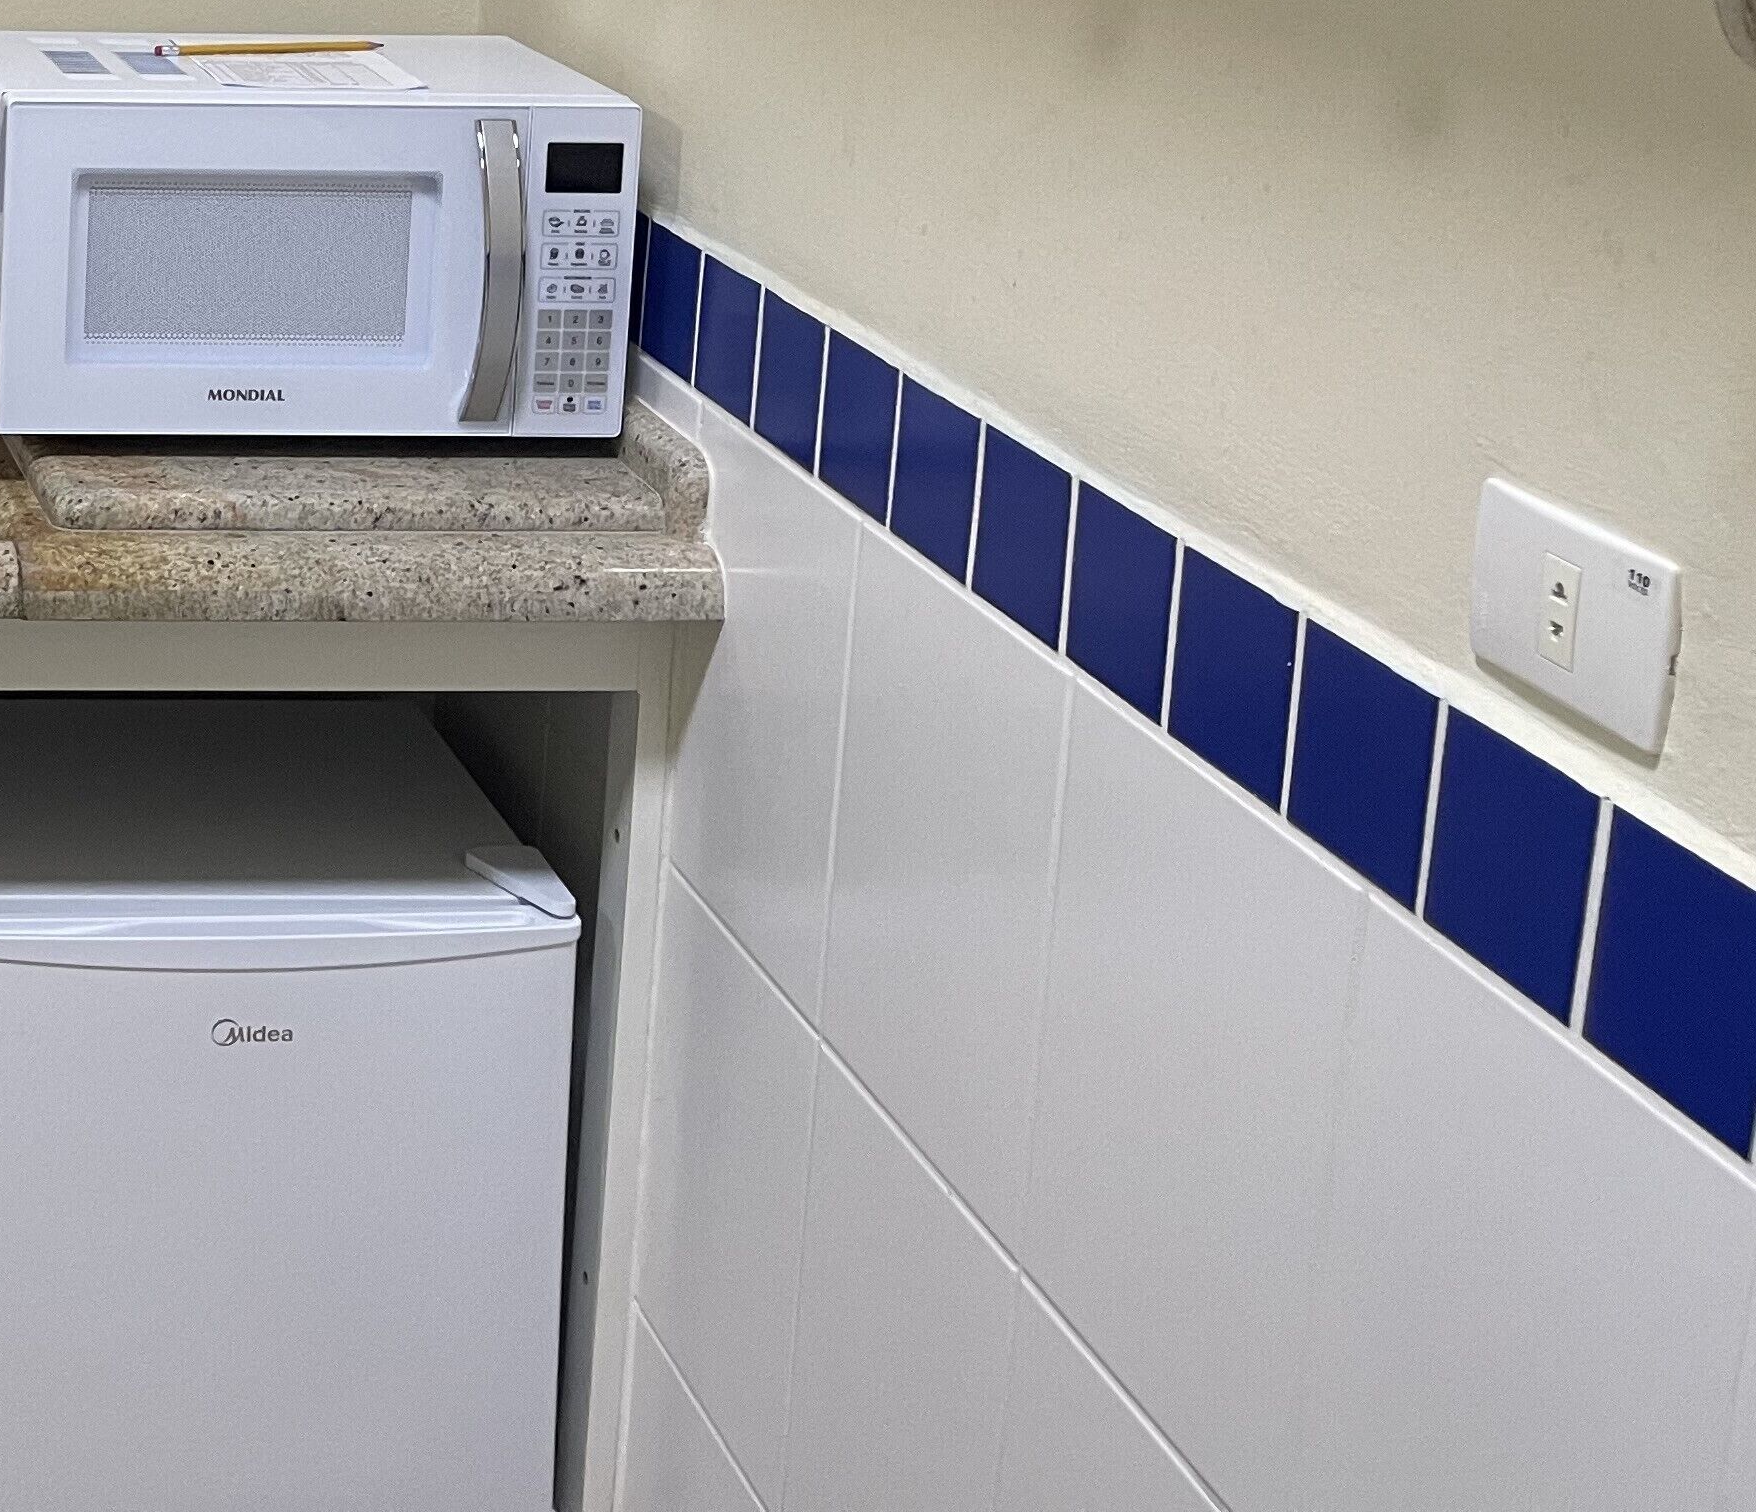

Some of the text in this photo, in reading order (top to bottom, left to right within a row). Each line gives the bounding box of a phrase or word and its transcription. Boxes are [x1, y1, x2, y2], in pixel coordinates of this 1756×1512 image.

[572, 314, 580, 325] 2
[597, 314, 605, 325] 3
[545, 335, 603, 346] 4 5 6
[544, 357, 551, 366] 7
[594, 357, 602, 367] 9
[567, 378, 575, 388] 0
[207, 389, 286, 402] MONDIAL
[1627, 568, 1651, 588] 110
[211, 1018, 293, 1046] Midea
